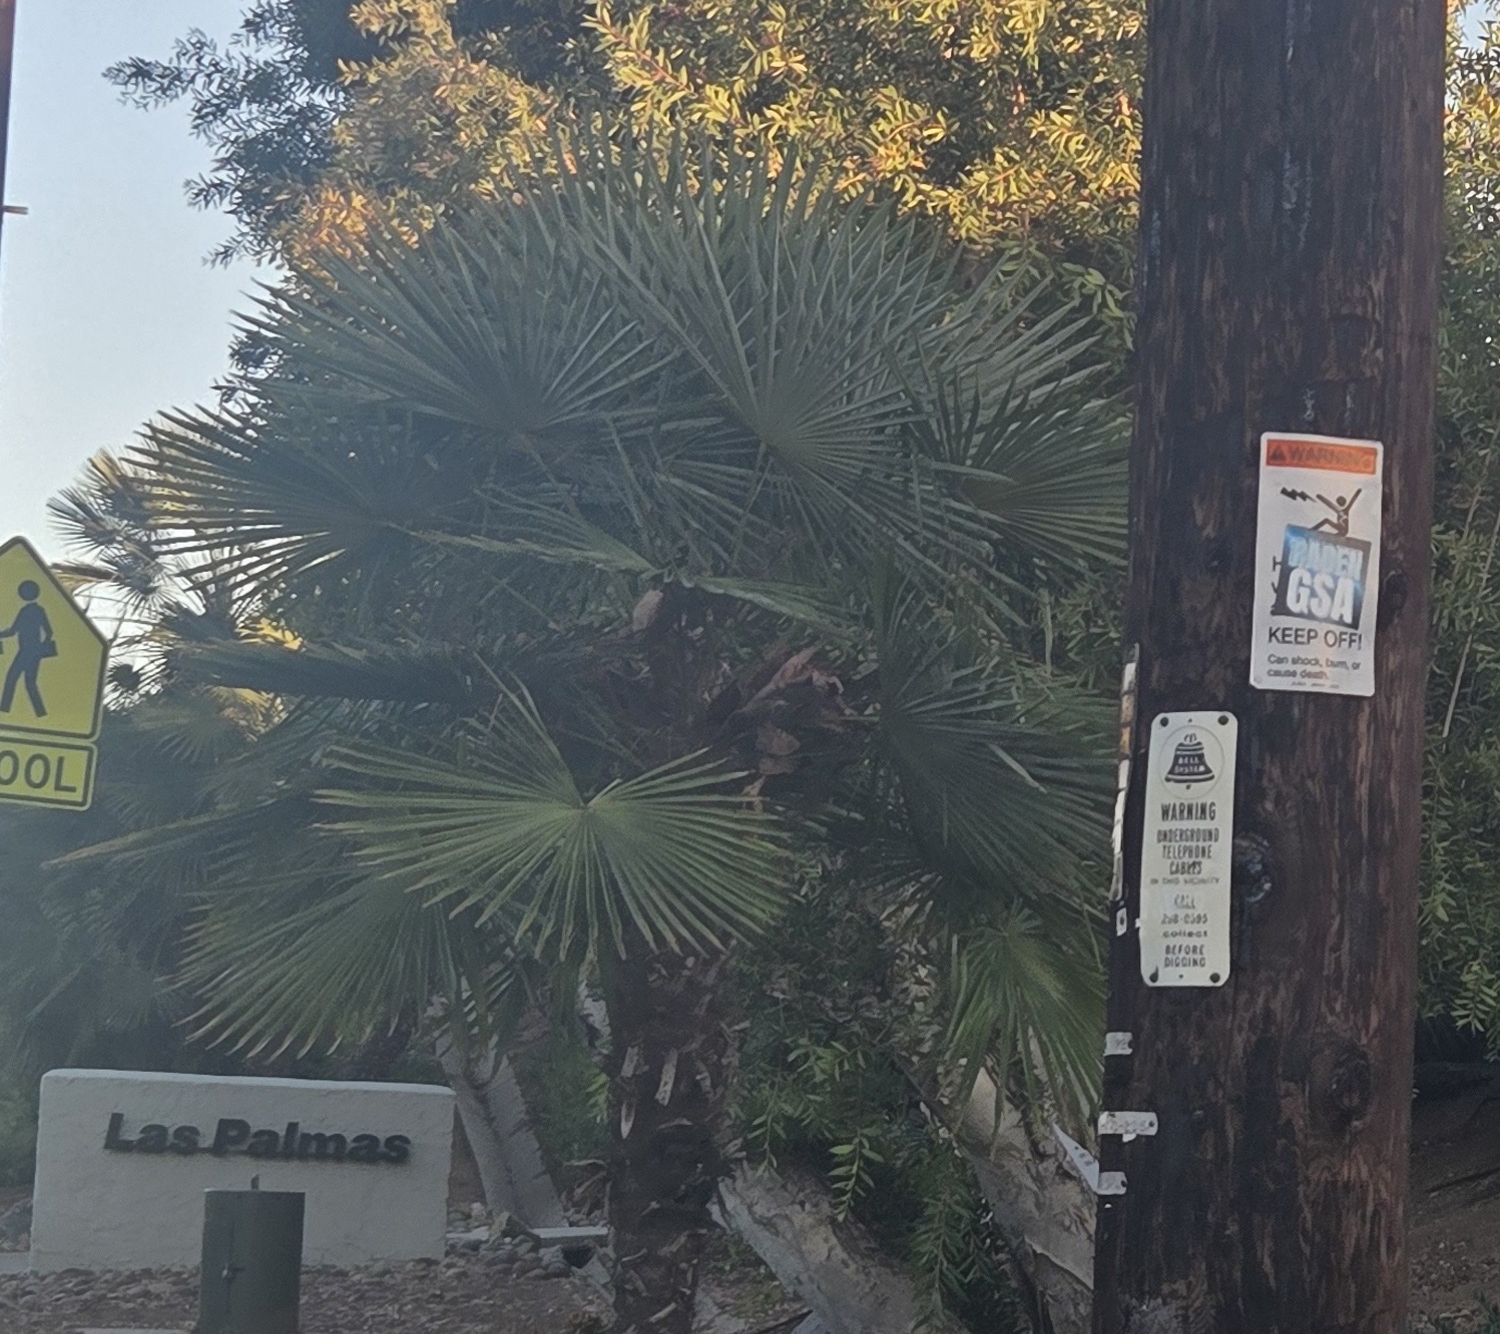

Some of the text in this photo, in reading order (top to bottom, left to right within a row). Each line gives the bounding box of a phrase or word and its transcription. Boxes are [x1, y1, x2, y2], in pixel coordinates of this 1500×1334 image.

[1286, 567, 1355, 624] GSA
[1267, 626, 1363, 651] KEEP OFF!
[1267, 653, 1289, 665] Can
[1291, 654, 1323, 668] shock,
[1351, 662, 1361, 670] or
[1266, 669, 1297, 678] cause
[1177, 756, 1200, 765] BELL
[1160, 802, 1216, 821] WARNING
[1156, 827, 1220, 845] UNDERGROUND
[1161, 844, 1213, 860] TELEPHONE
[1162, 930, 1208, 938] collect
[1164, 944, 1206, 956] BEFORE
[1163, 956, 1206, 968] DIGGING
[104, 1113, 412, 1163] Las Palmas
